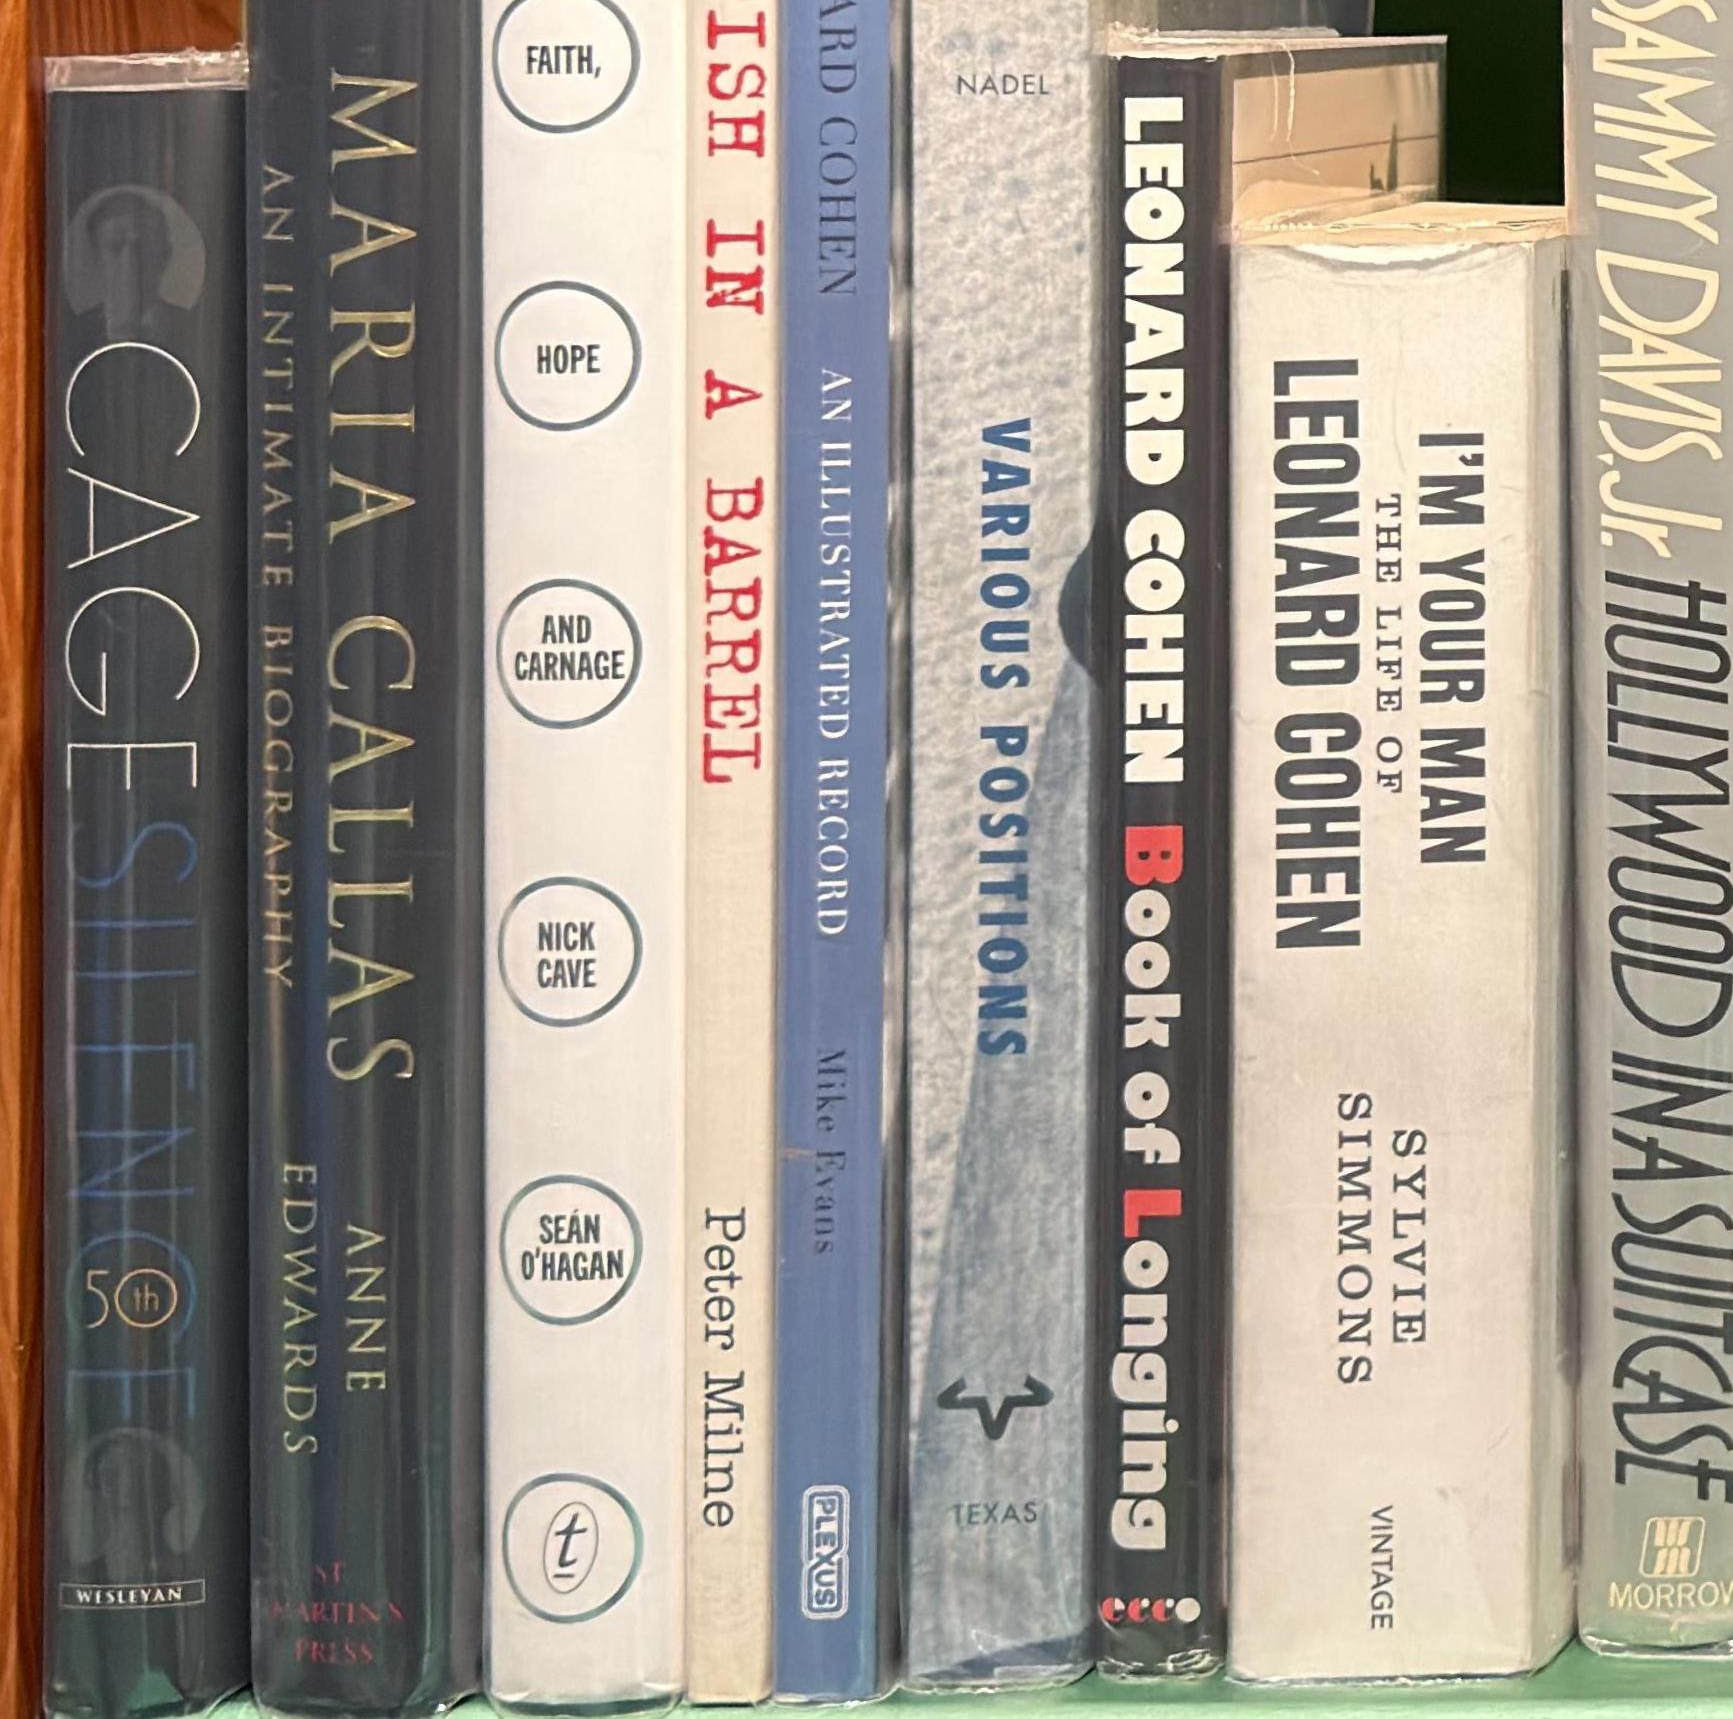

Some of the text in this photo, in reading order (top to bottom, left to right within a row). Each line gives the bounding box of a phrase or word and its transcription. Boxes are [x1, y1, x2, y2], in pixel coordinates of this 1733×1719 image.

[525, 45, 602, 78] FAITH,
[956, 74, 1050, 97] NADEL
[705, 218, 764, 315] IN
[818, 116, 859, 297] COHEN
[537, 345, 601, 375] HOPE
[705, 369, 762, 420] A
[820, 367, 852, 423] AN
[64, 341, 200, 790] CAGE
[262, 164, 296, 988] AN INTIMATE BIOGRAPHY
[326, 69, 418, 1079] MARIA CALLAS
[818, 444, 853, 739] ILLUSTRATED
[1598, 469, 1723, 560] Jr.
[513, 650, 626, 681] CARNAGE
[541, 615, 592, 644] AND
[703, 476, 763, 784] BARREL
[1273, 358, 1362, 949] LEONARD COHEN
[1377, 493, 1402, 794] THE LIFE OF
[1418, 433, 1486, 864] I'M YOUR MAN
[978, 416, 1032, 1057] VARIOUS POSITIONS
[1111, 96, 1186, 1551] LEONARD COHEN Book of Longing
[814, 756, 849, 937] RECORD
[538, 922, 595, 953] NICK
[538, 958, 598, 989] CAVE
[539, 1208, 601, 1243] SEÁN
[814, 1048, 848, 1255] Mike Evans
[1338, 1092, 1372, 1385] SIMMONS
[1393, 1129, 1427, 1346] SYLVIE
[282, 1164, 318, 1456] EDWARDS
[346, 1224, 386, 1393] ANNE
[521, 1249, 624, 1282] O'HAGAN
[703, 1207, 746, 1529] Peter Milne
[76, 1586, 182, 1604] WESLEYAN
[952, 1501, 1038, 1525] TEXAS
[1369, 1506, 1395, 1630] VINTAGE
